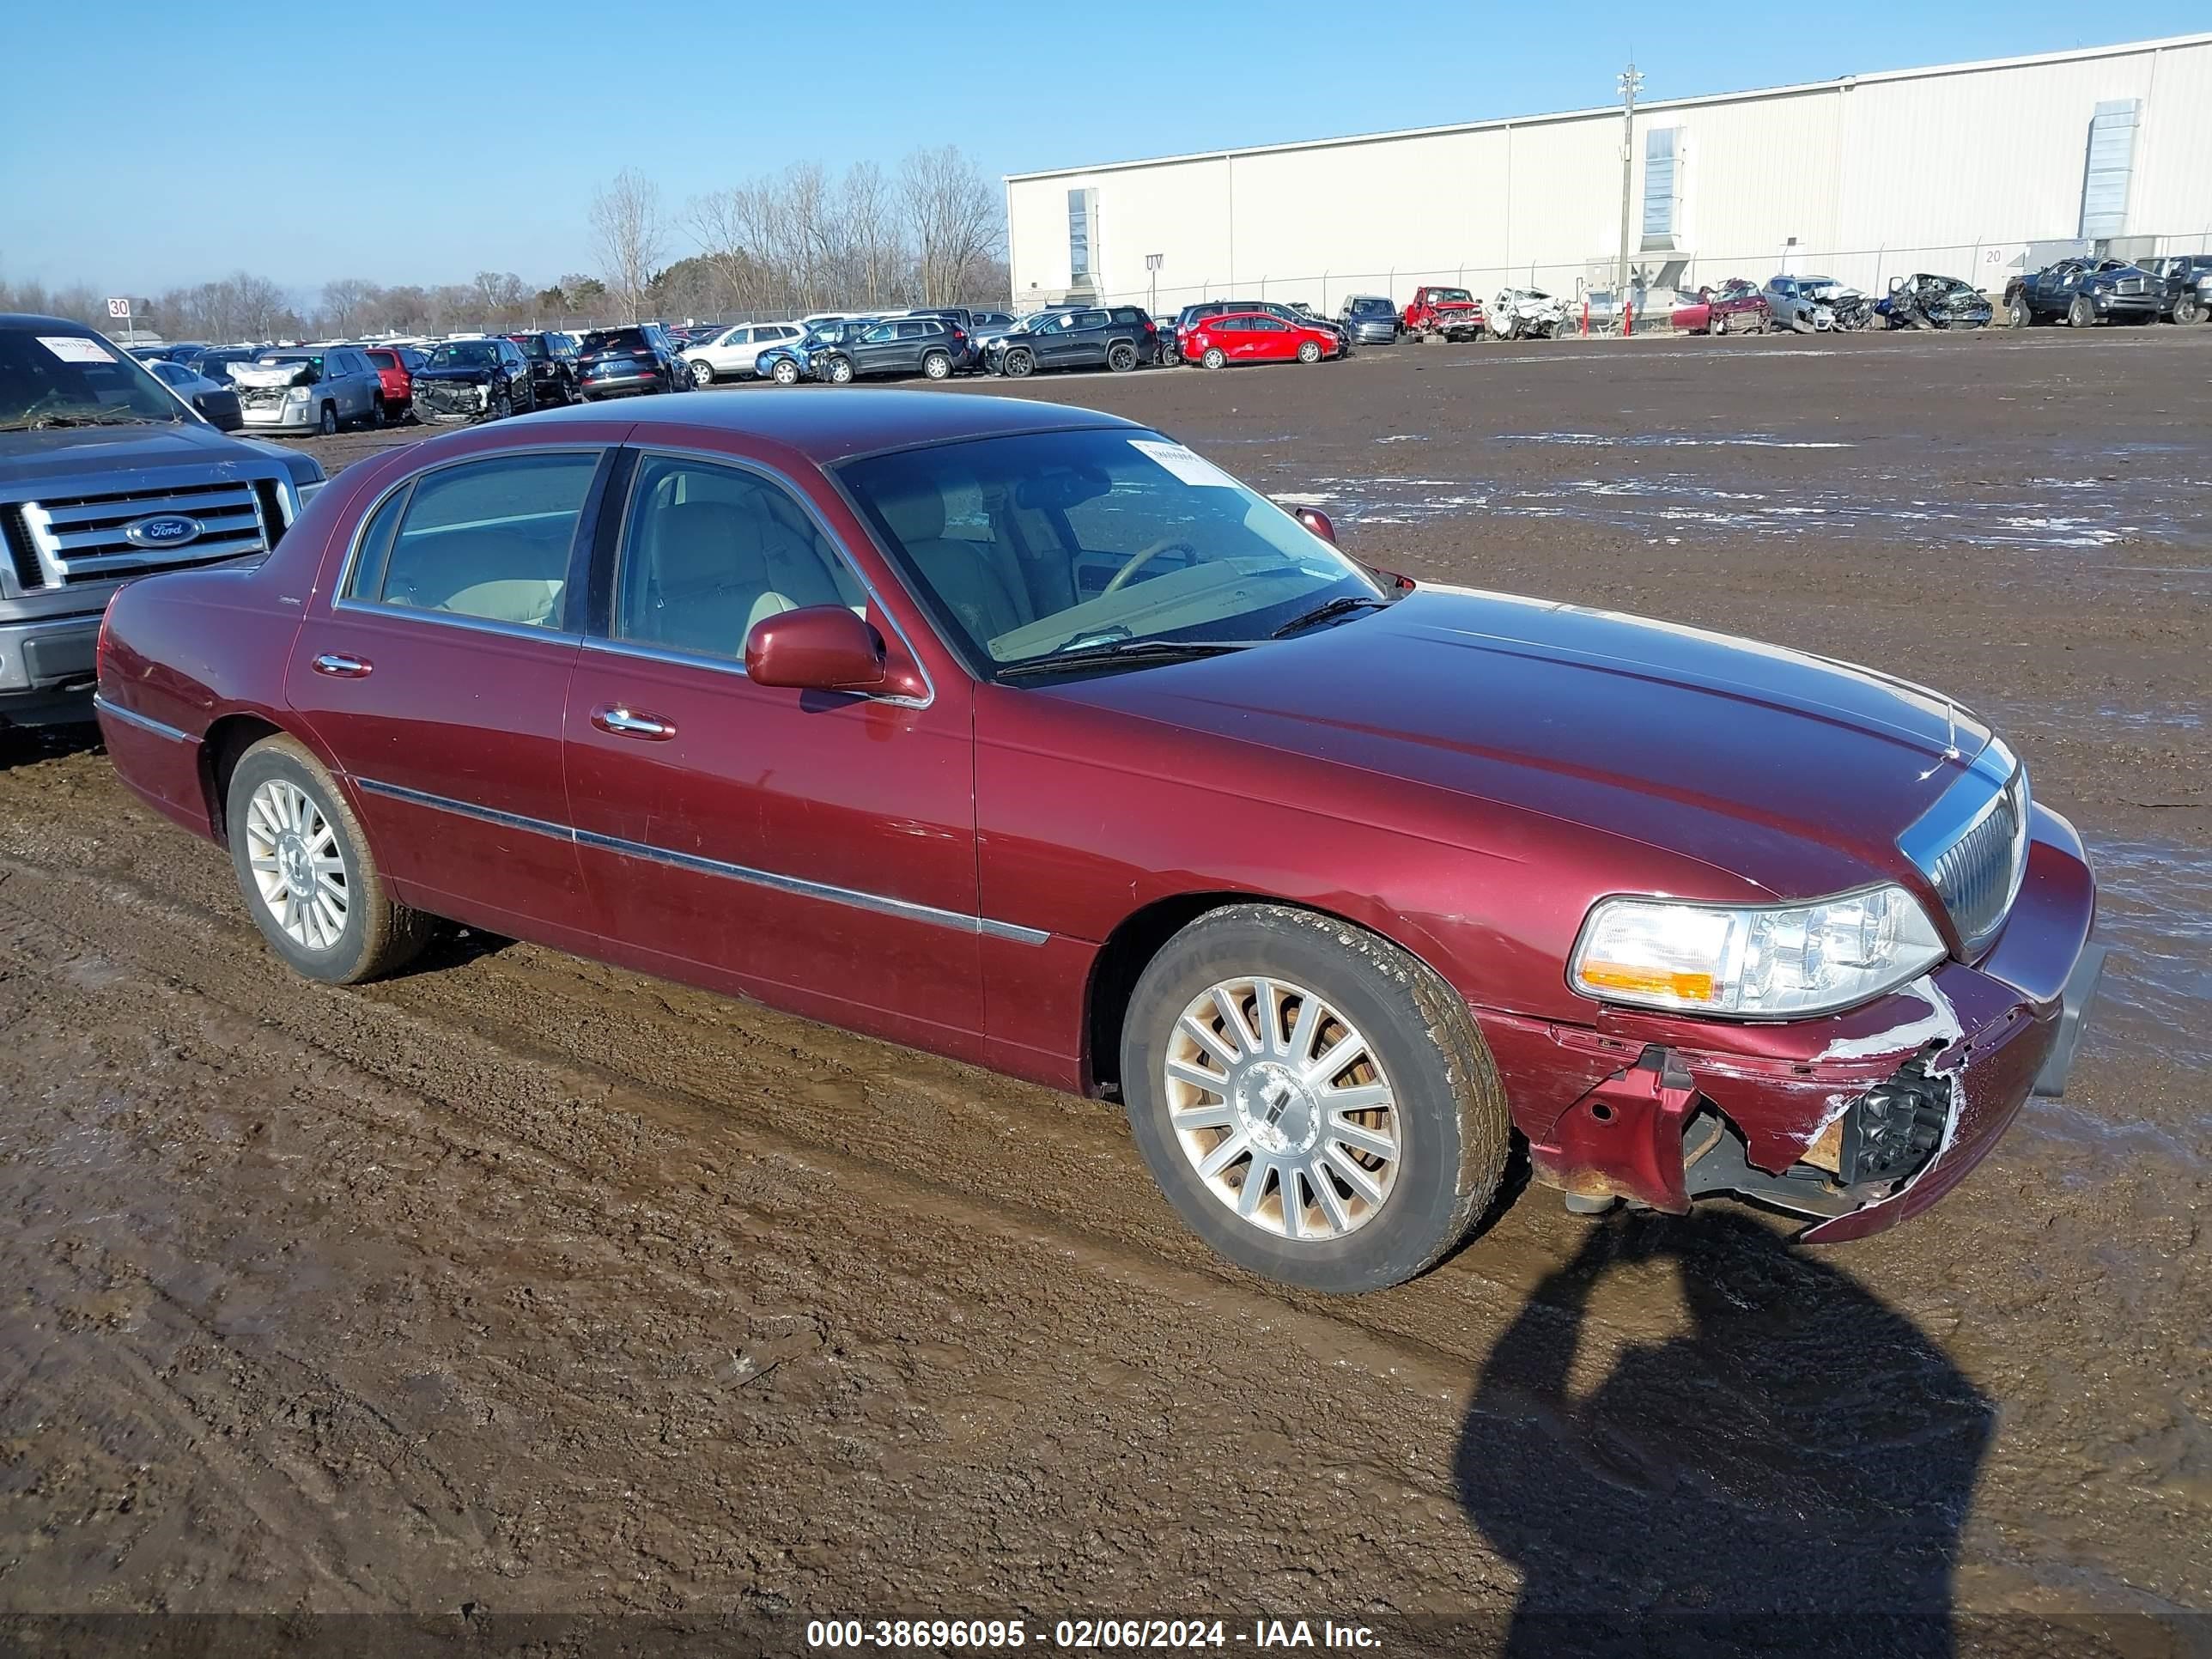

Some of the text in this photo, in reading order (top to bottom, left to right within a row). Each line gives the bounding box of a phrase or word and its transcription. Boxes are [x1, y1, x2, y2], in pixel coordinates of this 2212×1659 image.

[1986, 250, 2001, 263] 20
[110, 301, 128, 315] 30
[151, 522, 183, 537] Ford
